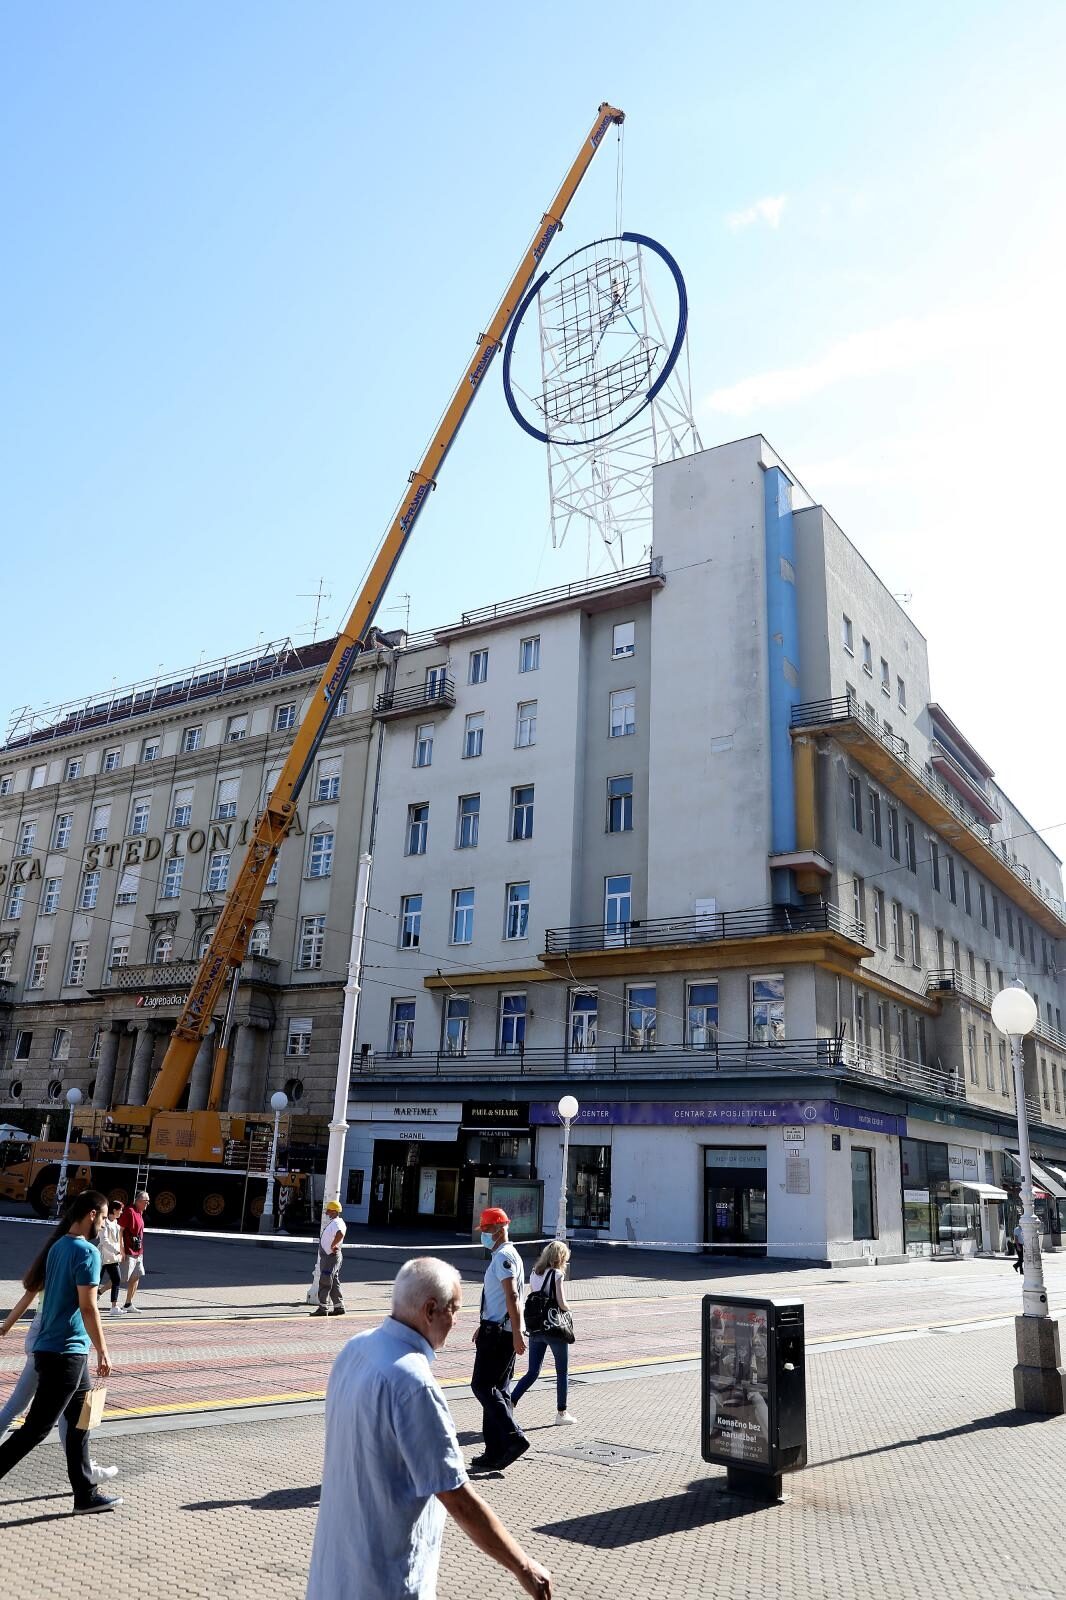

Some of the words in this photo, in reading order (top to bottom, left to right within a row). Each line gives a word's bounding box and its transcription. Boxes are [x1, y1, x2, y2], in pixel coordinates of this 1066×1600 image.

[536, 222, 559, 254] PRANGL
[473, 342, 498, 379] PRANGL
[403, 482, 429, 523] PRANGL
[393, 1107, 437, 1116] MARTIMEX
[674, 1110, 705, 1118] CENTAR
[400, 1132, 425, 1140] CHANEL
[717, 1416, 747, 1429] Konačno
[748, 1421, 761, 1432] bez
